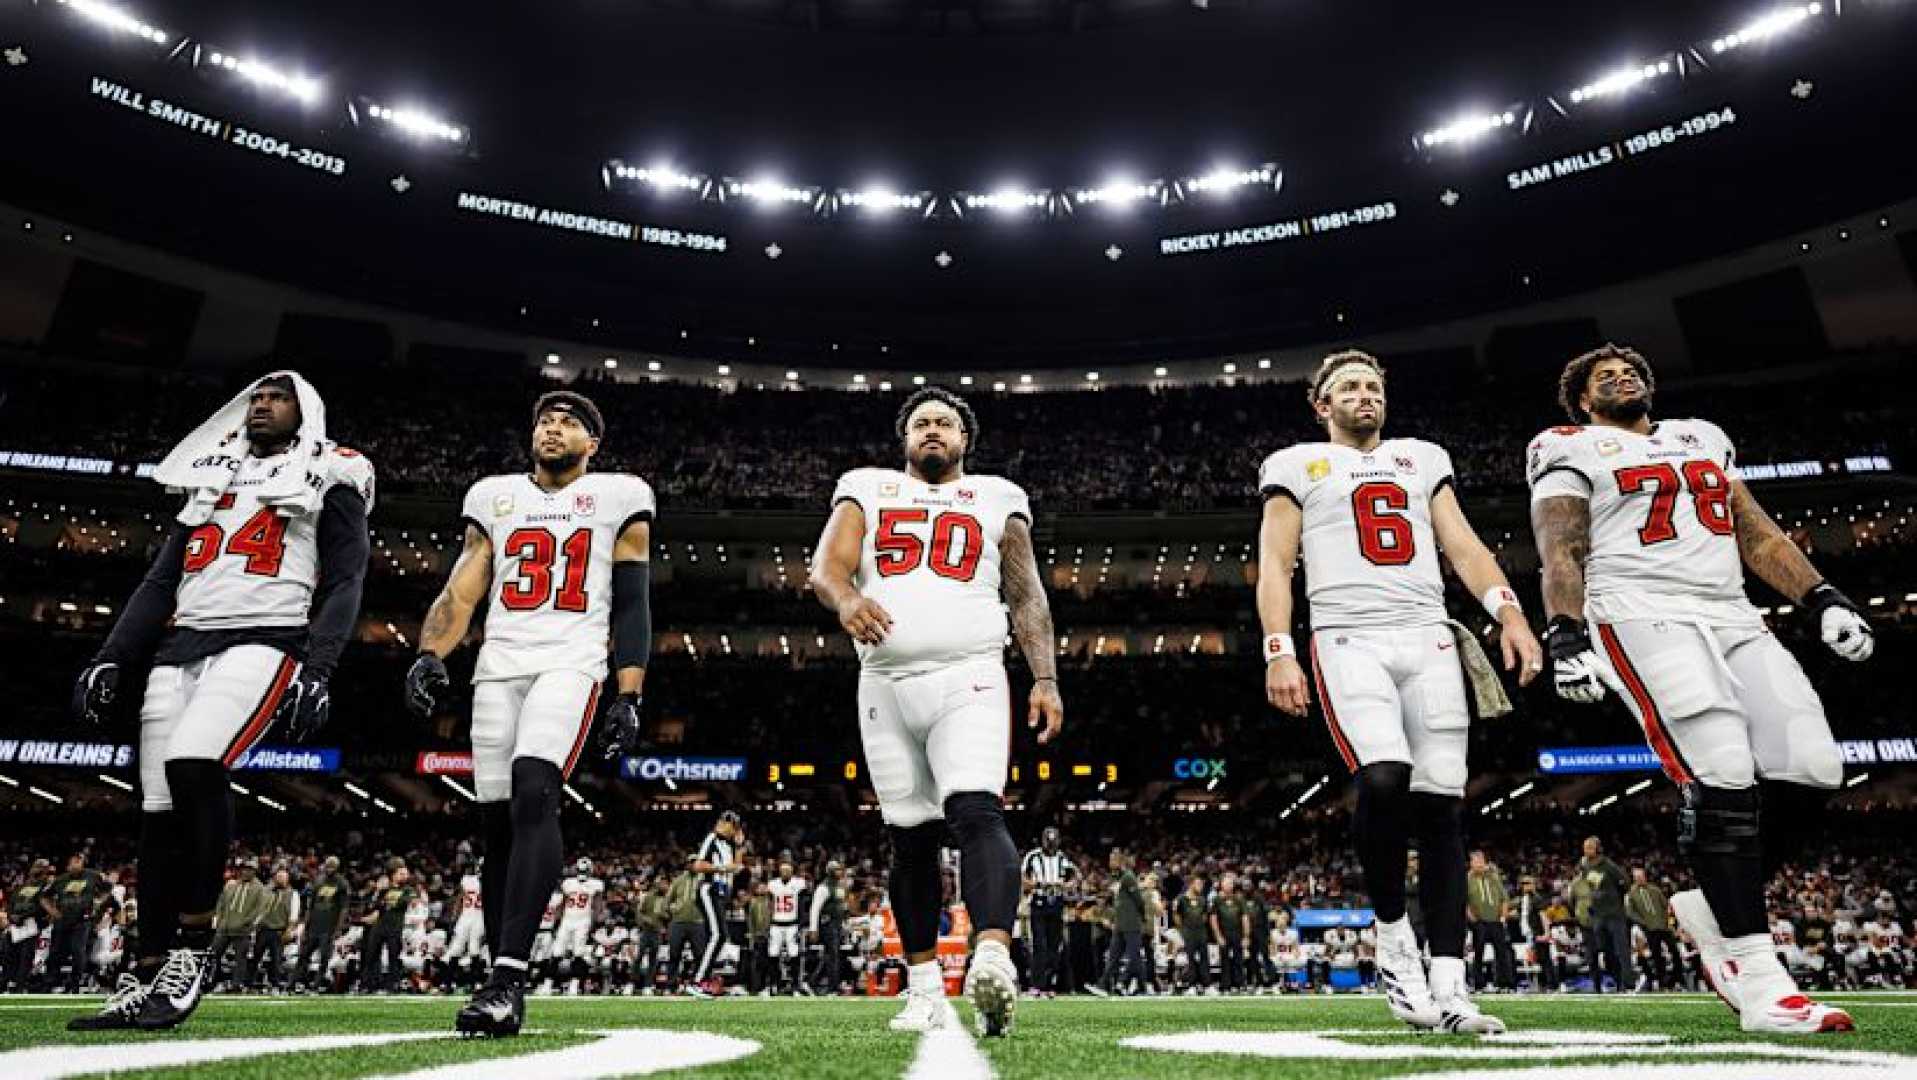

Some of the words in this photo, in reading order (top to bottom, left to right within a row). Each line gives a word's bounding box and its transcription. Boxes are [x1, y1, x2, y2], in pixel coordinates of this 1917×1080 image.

[92, 77, 145, 110] WILL
[149, 99, 220, 137] SMITH
[232, 127, 345, 175] 2004-2013
[1507, 159, 1552, 189] SAM
[1554, 146, 1613, 177] MILLS
[1624, 106, 1736, 155] 1986-1994
[458, 192, 536, 220] MORTEN
[537, 209, 632, 239] ANDERSEN
[642, 227, 727, 252] 1982-1994
[1161, 232, 1220, 254] RICKEY
[1222, 220, 1300, 247] JACKSON
[1311, 202, 1397, 232] 1981-1993
[1352, 481, 1415, 566] 6
[1614, 459, 1732, 546] 78
[500, 527, 593, 612] 31
[875, 508, 983, 582] 50
[19, 740, 115, 766] ORLEANS
[641, 757, 743, 780] Ochsner
[1174, 758, 1228, 779] COX
[774, 894, 794, 914] 15
